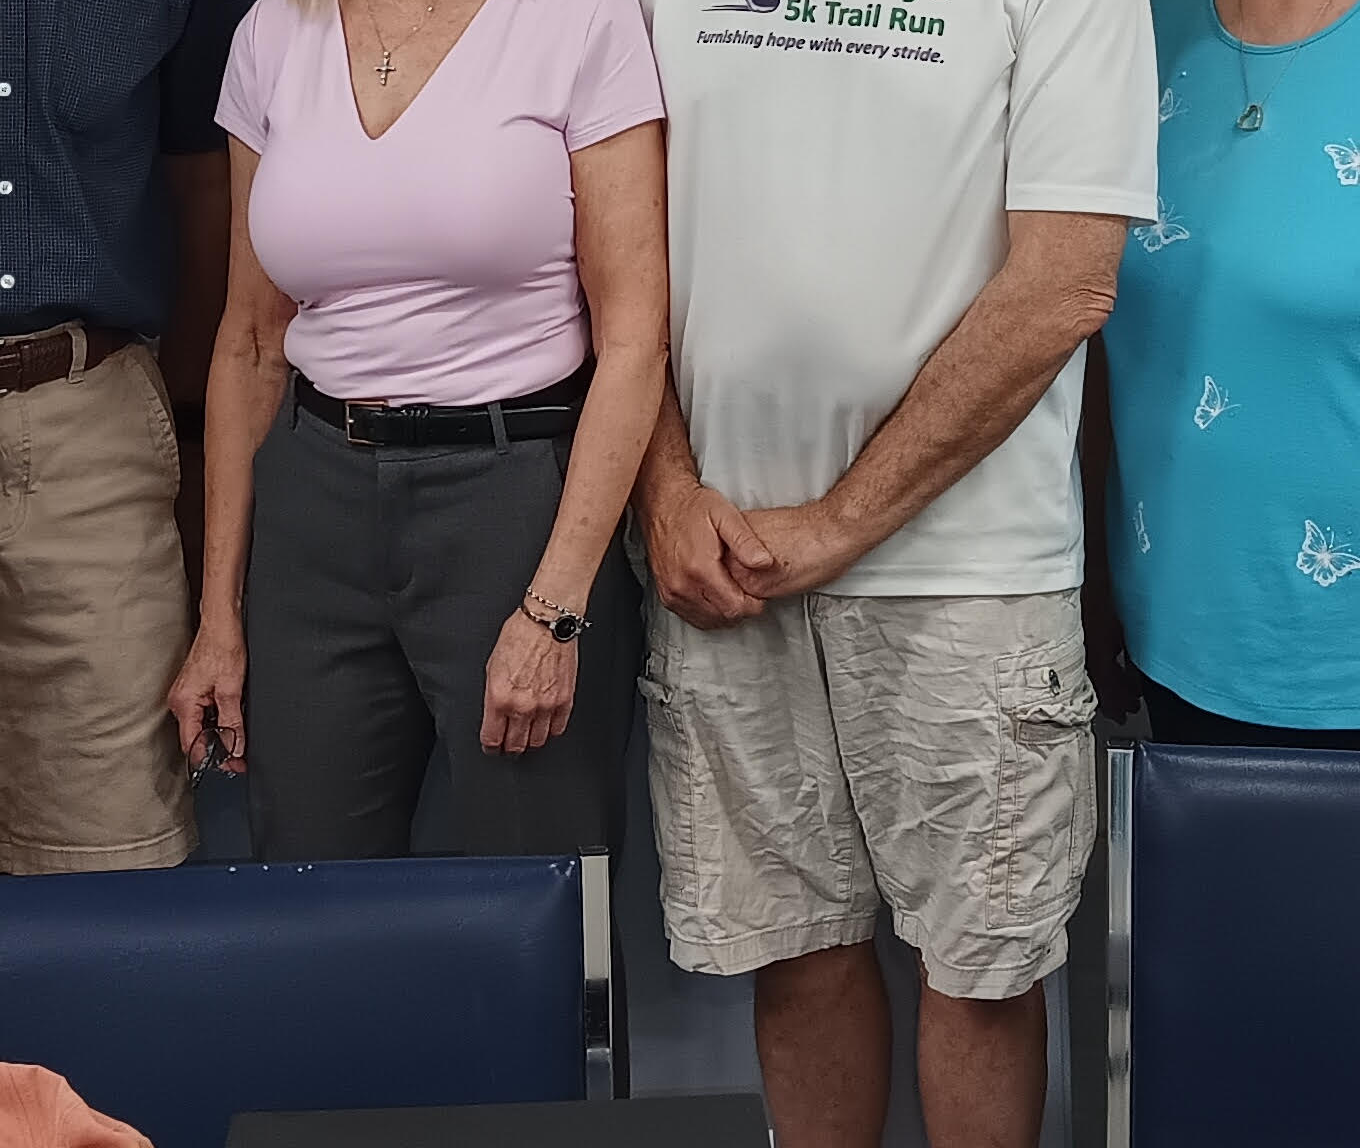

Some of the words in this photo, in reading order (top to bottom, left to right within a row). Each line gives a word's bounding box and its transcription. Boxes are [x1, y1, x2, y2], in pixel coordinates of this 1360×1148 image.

[826, 1, 882, 28] Trail
[889, 7, 945, 36] Run
[696, 29, 764, 49] Furnishing
[766, 31, 806, 51] hope
[809, 37, 843, 53] with
[845, 41, 890, 59] every
[892, 46, 944, 64] stride.
